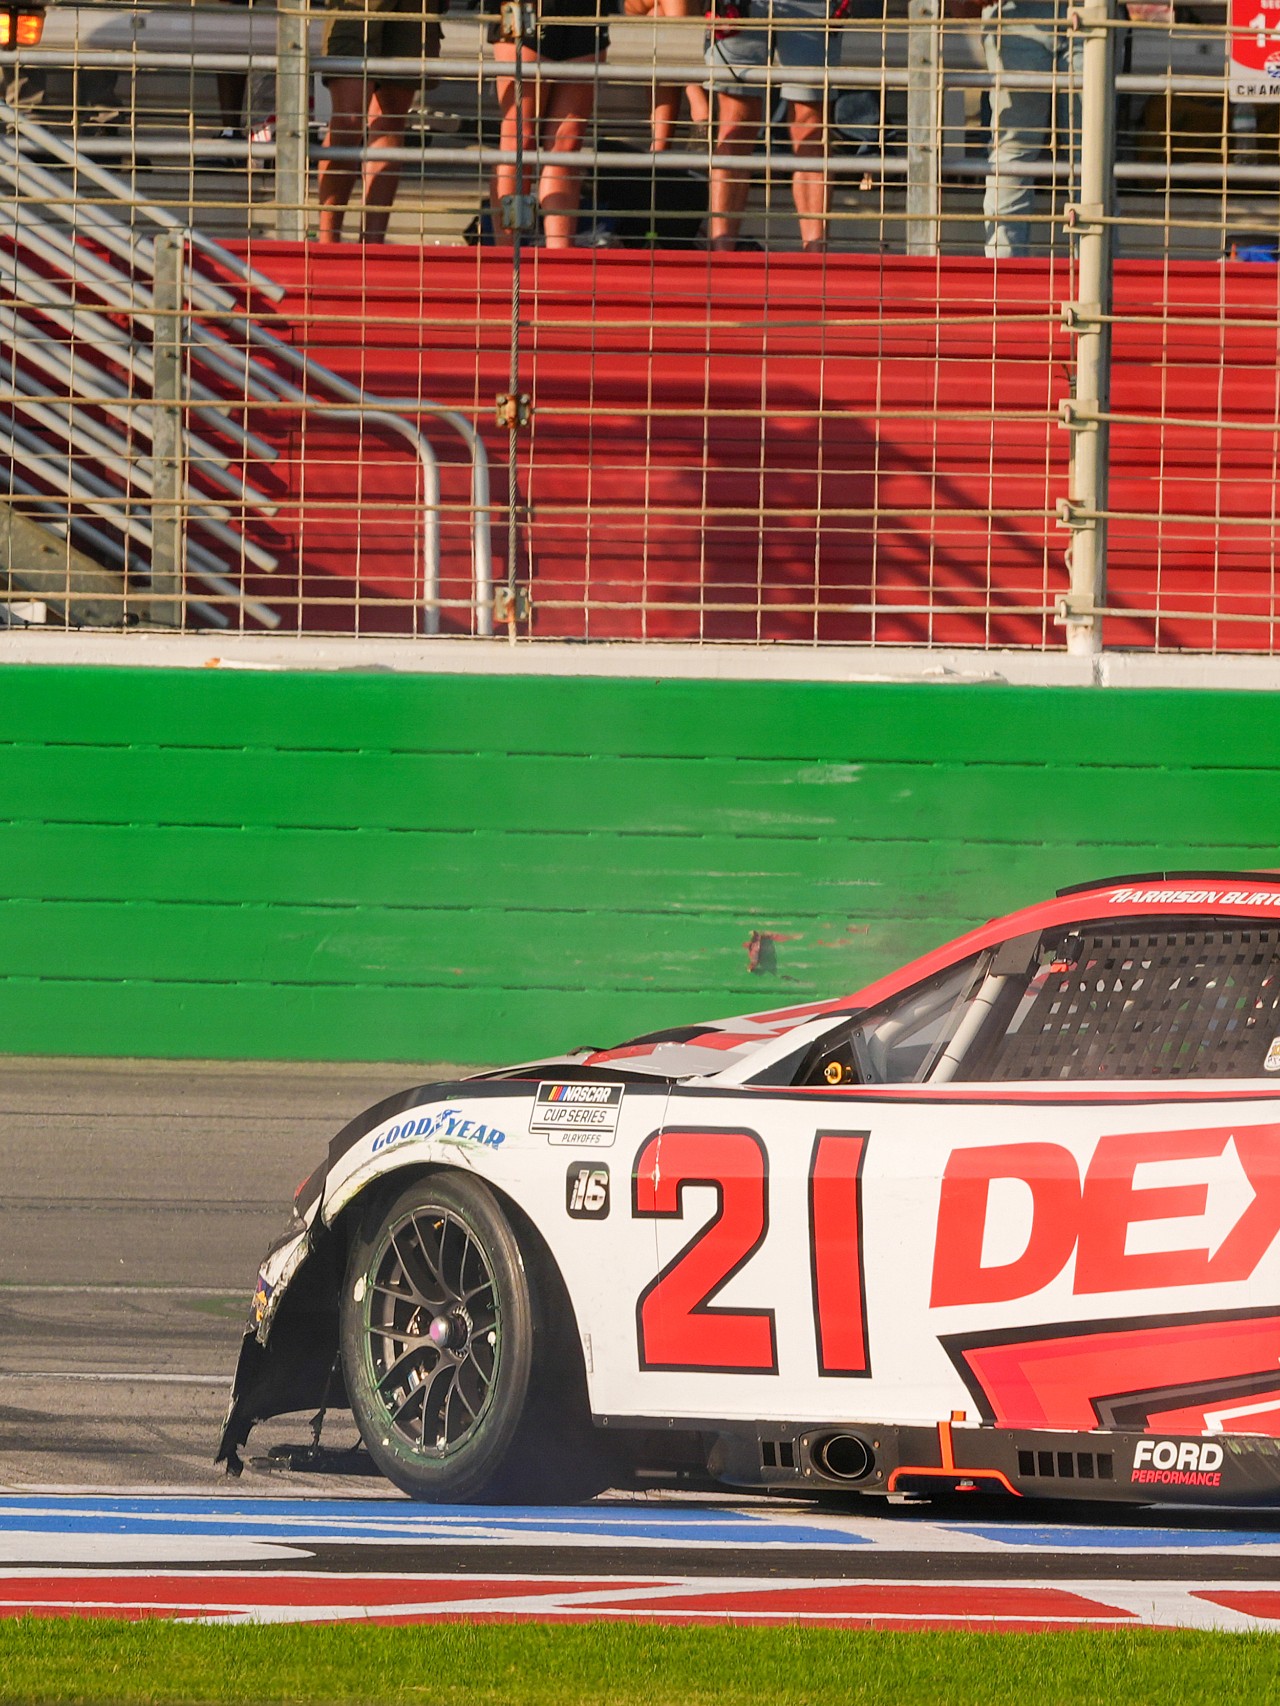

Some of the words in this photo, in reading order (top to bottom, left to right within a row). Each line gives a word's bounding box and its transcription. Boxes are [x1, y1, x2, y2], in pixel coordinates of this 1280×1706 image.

[1108, 888, 1222, 904] HARRISON
[563, 1086, 612, 1103] NASCAR
[543, 1109, 567, 1123] CUP
[567, 1109, 607, 1123] SERIES
[371, 1115, 506, 1152] GOODYEAR
[561, 1133, 602, 1143] PLAYOFFS
[574, 1169, 609, 1211] 16
[632, 1126, 873, 1379] 21
[1133, 1440, 1224, 1471] FORD
[1131, 1470, 1222, 1487] PERFORMANCE
